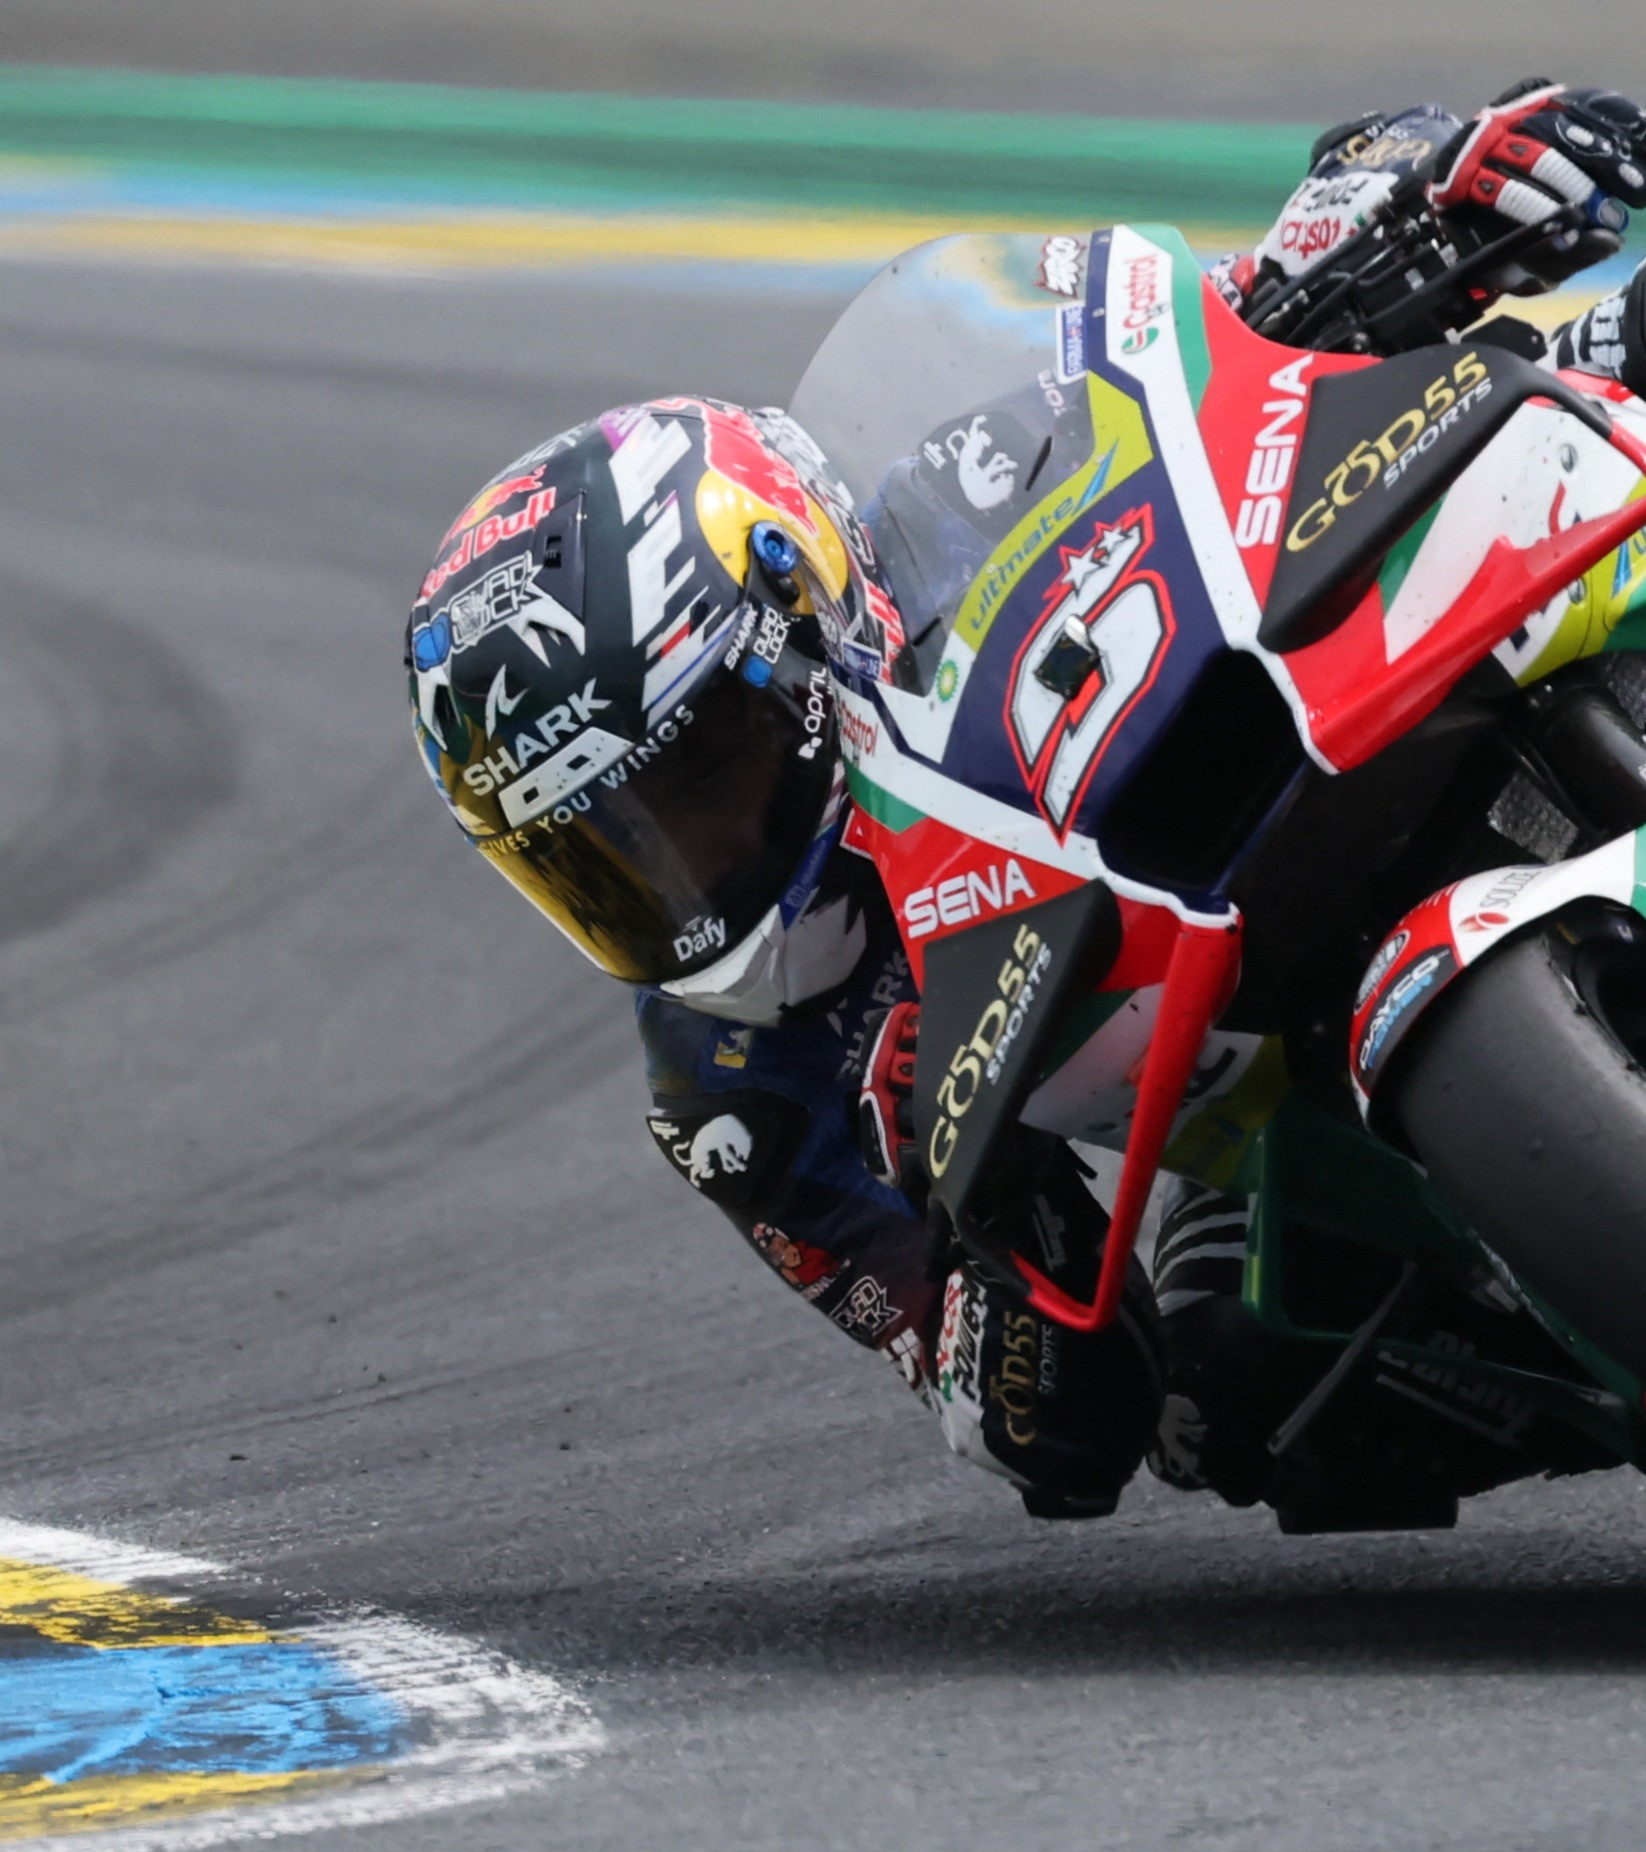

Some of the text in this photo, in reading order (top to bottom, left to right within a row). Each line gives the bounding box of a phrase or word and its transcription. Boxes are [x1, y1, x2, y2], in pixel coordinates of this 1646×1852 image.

[1235, 354, 1314, 548] SENA
[1383, 378, 1493, 490] SPORTS
[473, 487, 557, 559] Bull
[970, 496, 1075, 630] ultimate
[724, 602, 758, 671] SHARK
[753, 606, 778, 656] QUAD
[765, 613, 791, 665] LOCK
[463, 677, 612, 796] SHARK
[536, 791, 592, 834] YOU
[601, 704, 694, 790] WINGS
[674, 917, 727, 962] Dafy
[904, 858, 1036, 939] SENA
[840, 949, 910, 1075] SHRK
[987, 942, 1051, 1086] SPORTS
[1360, 955, 1440, 1071] DAYCO
